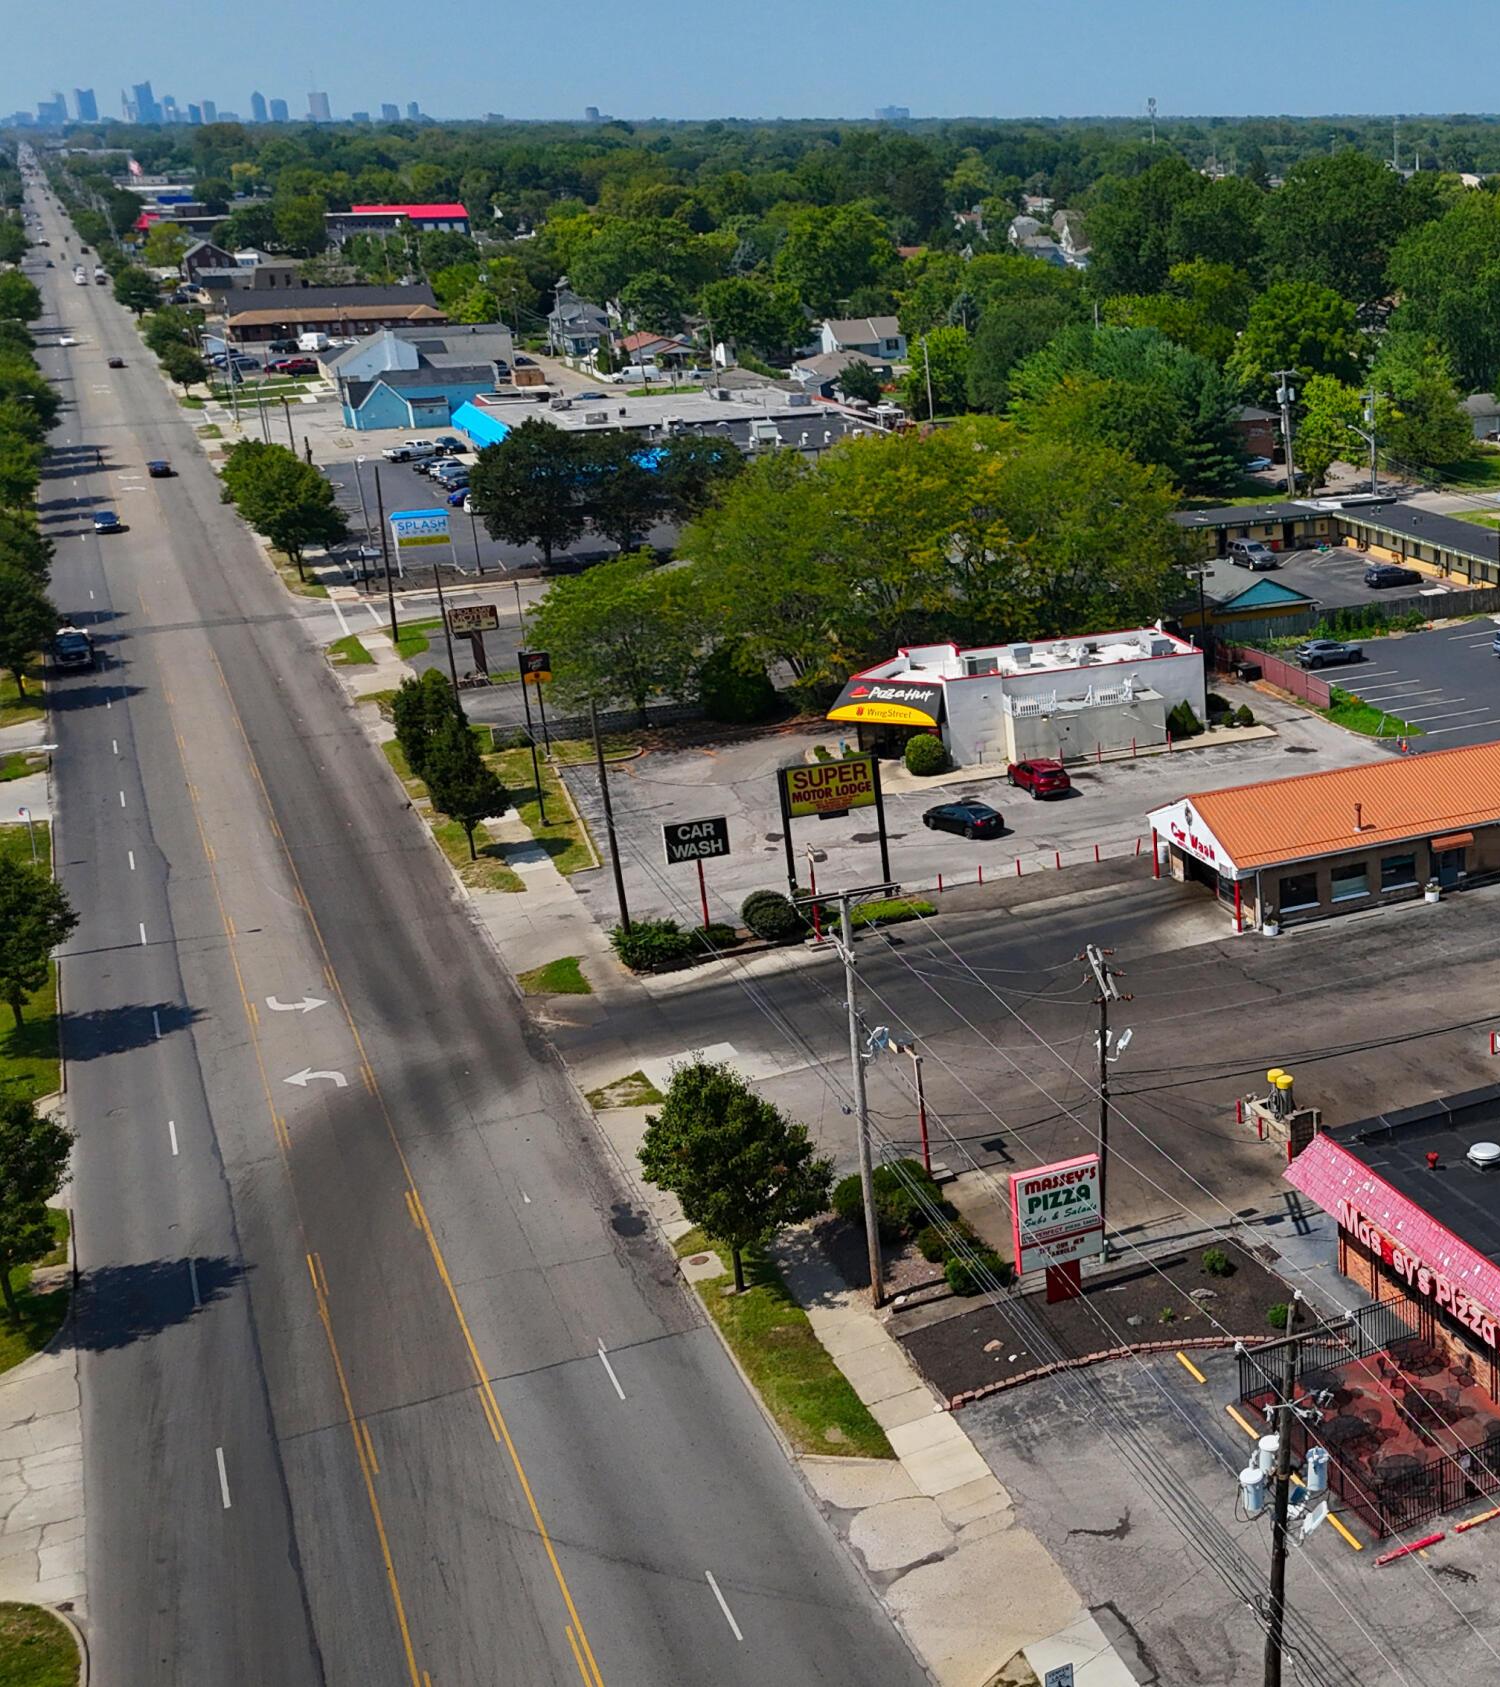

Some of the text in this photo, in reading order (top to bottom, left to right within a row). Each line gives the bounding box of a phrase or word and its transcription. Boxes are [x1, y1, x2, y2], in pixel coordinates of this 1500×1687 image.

[397, 519, 447, 531] SPLASH
[867, 686, 935, 702] Pizza Hut
[867, 708, 912, 719] WingStreet
[793, 762, 868, 790] SUPER
[792, 787, 833, 804] MOTOR
[836, 781, 872, 797] LODGE
[677, 822, 715, 840] CAR
[672, 838, 724, 859] WASH
[1190, 833, 1215, 861] Wash
[1024, 1166, 1097, 1196] MASSEY'S
[1027, 1184, 1091, 1215] PIZZA
[1023, 1202, 1098, 1229] Subs & Salads
[1337, 1199, 1432, 1296] Masey's
